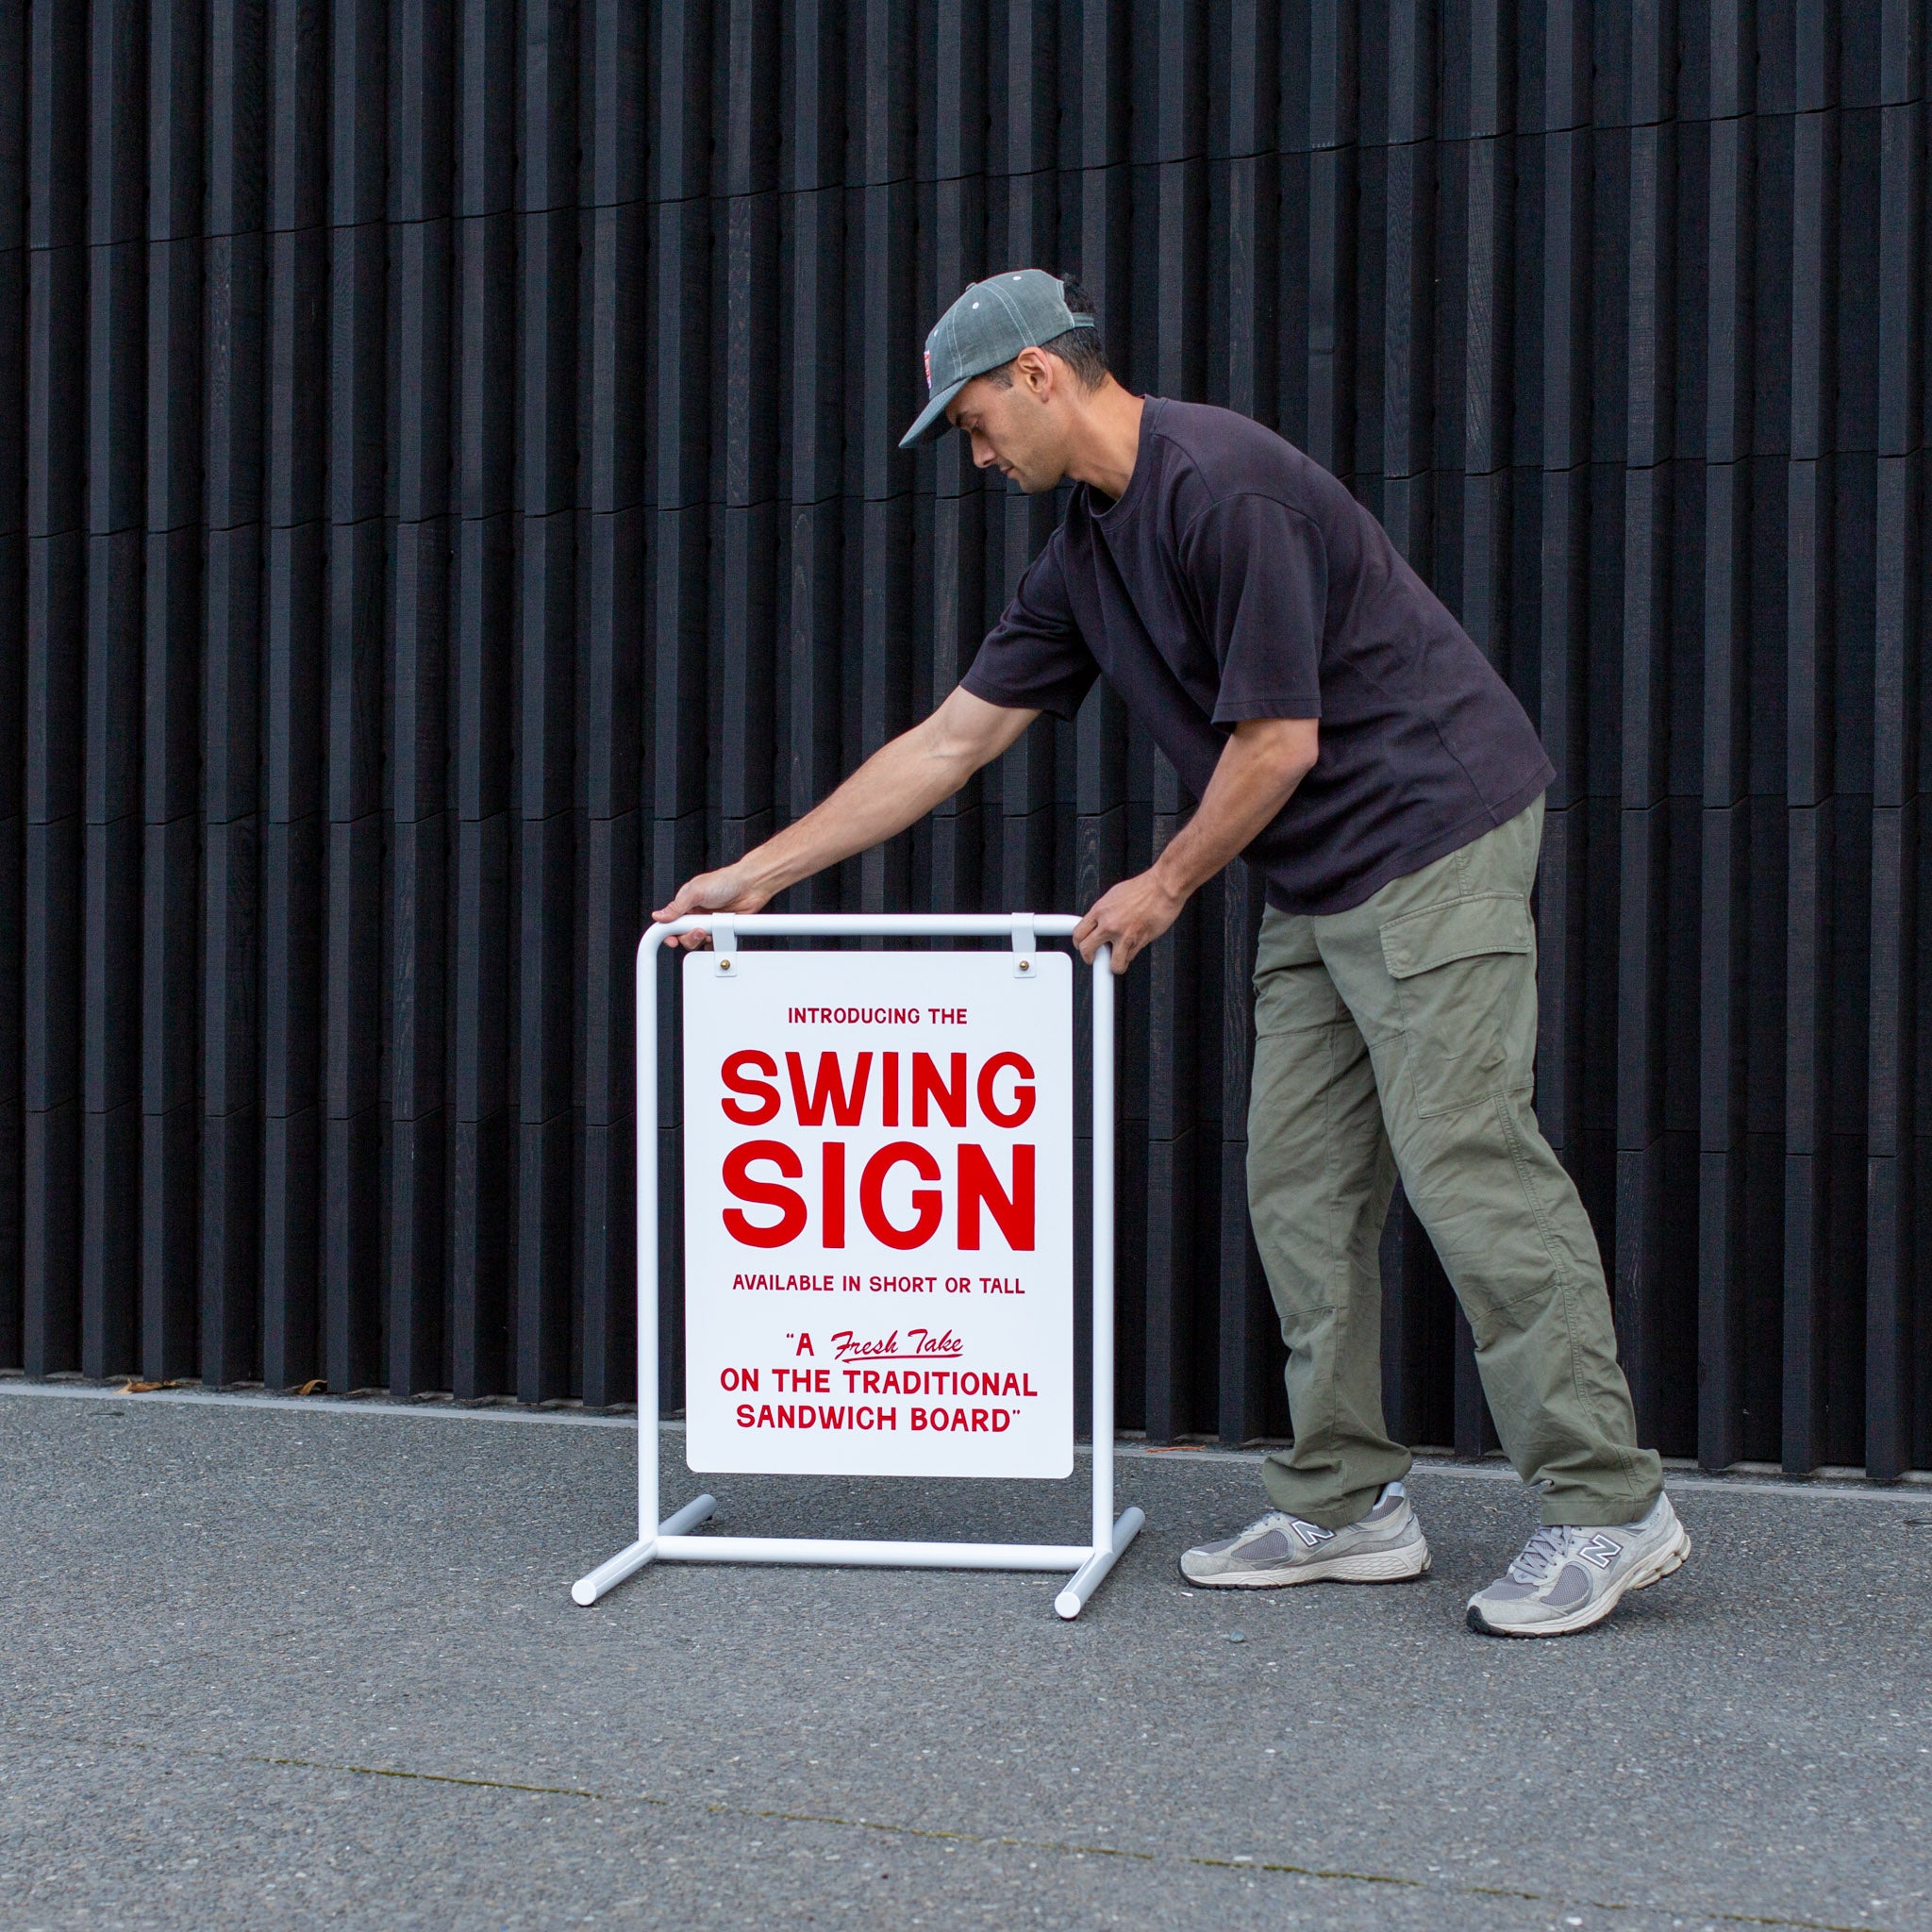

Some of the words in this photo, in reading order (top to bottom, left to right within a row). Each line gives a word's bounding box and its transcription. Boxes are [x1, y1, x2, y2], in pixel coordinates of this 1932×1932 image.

[789, 1007, 921, 1024] INTRODUCING
[928, 1008, 967, 1024] THE
[720, 1048, 1037, 1128] SWING
[721, 1139, 1037, 1252] SIGN
[733, 1274, 834, 1291] AVAILABLE
[842, 1275, 861, 1291] IN
[869, 1275, 938, 1293] SHORT
[945, 1277, 972, 1293] OR
[979, 1277, 1025, 1294] TALL
[830, 1329, 898, 1359] Fresh
[908, 1328, 963, 1355] Take
[720, 1367, 759, 1392] ON
[772, 1369, 831, 1393] THE
[842, 1370, 1039, 1397] TRADITIONAL
[736, 1404, 897, 1430] SANDWICH
[1577, 1532, 1624, 1570] N
